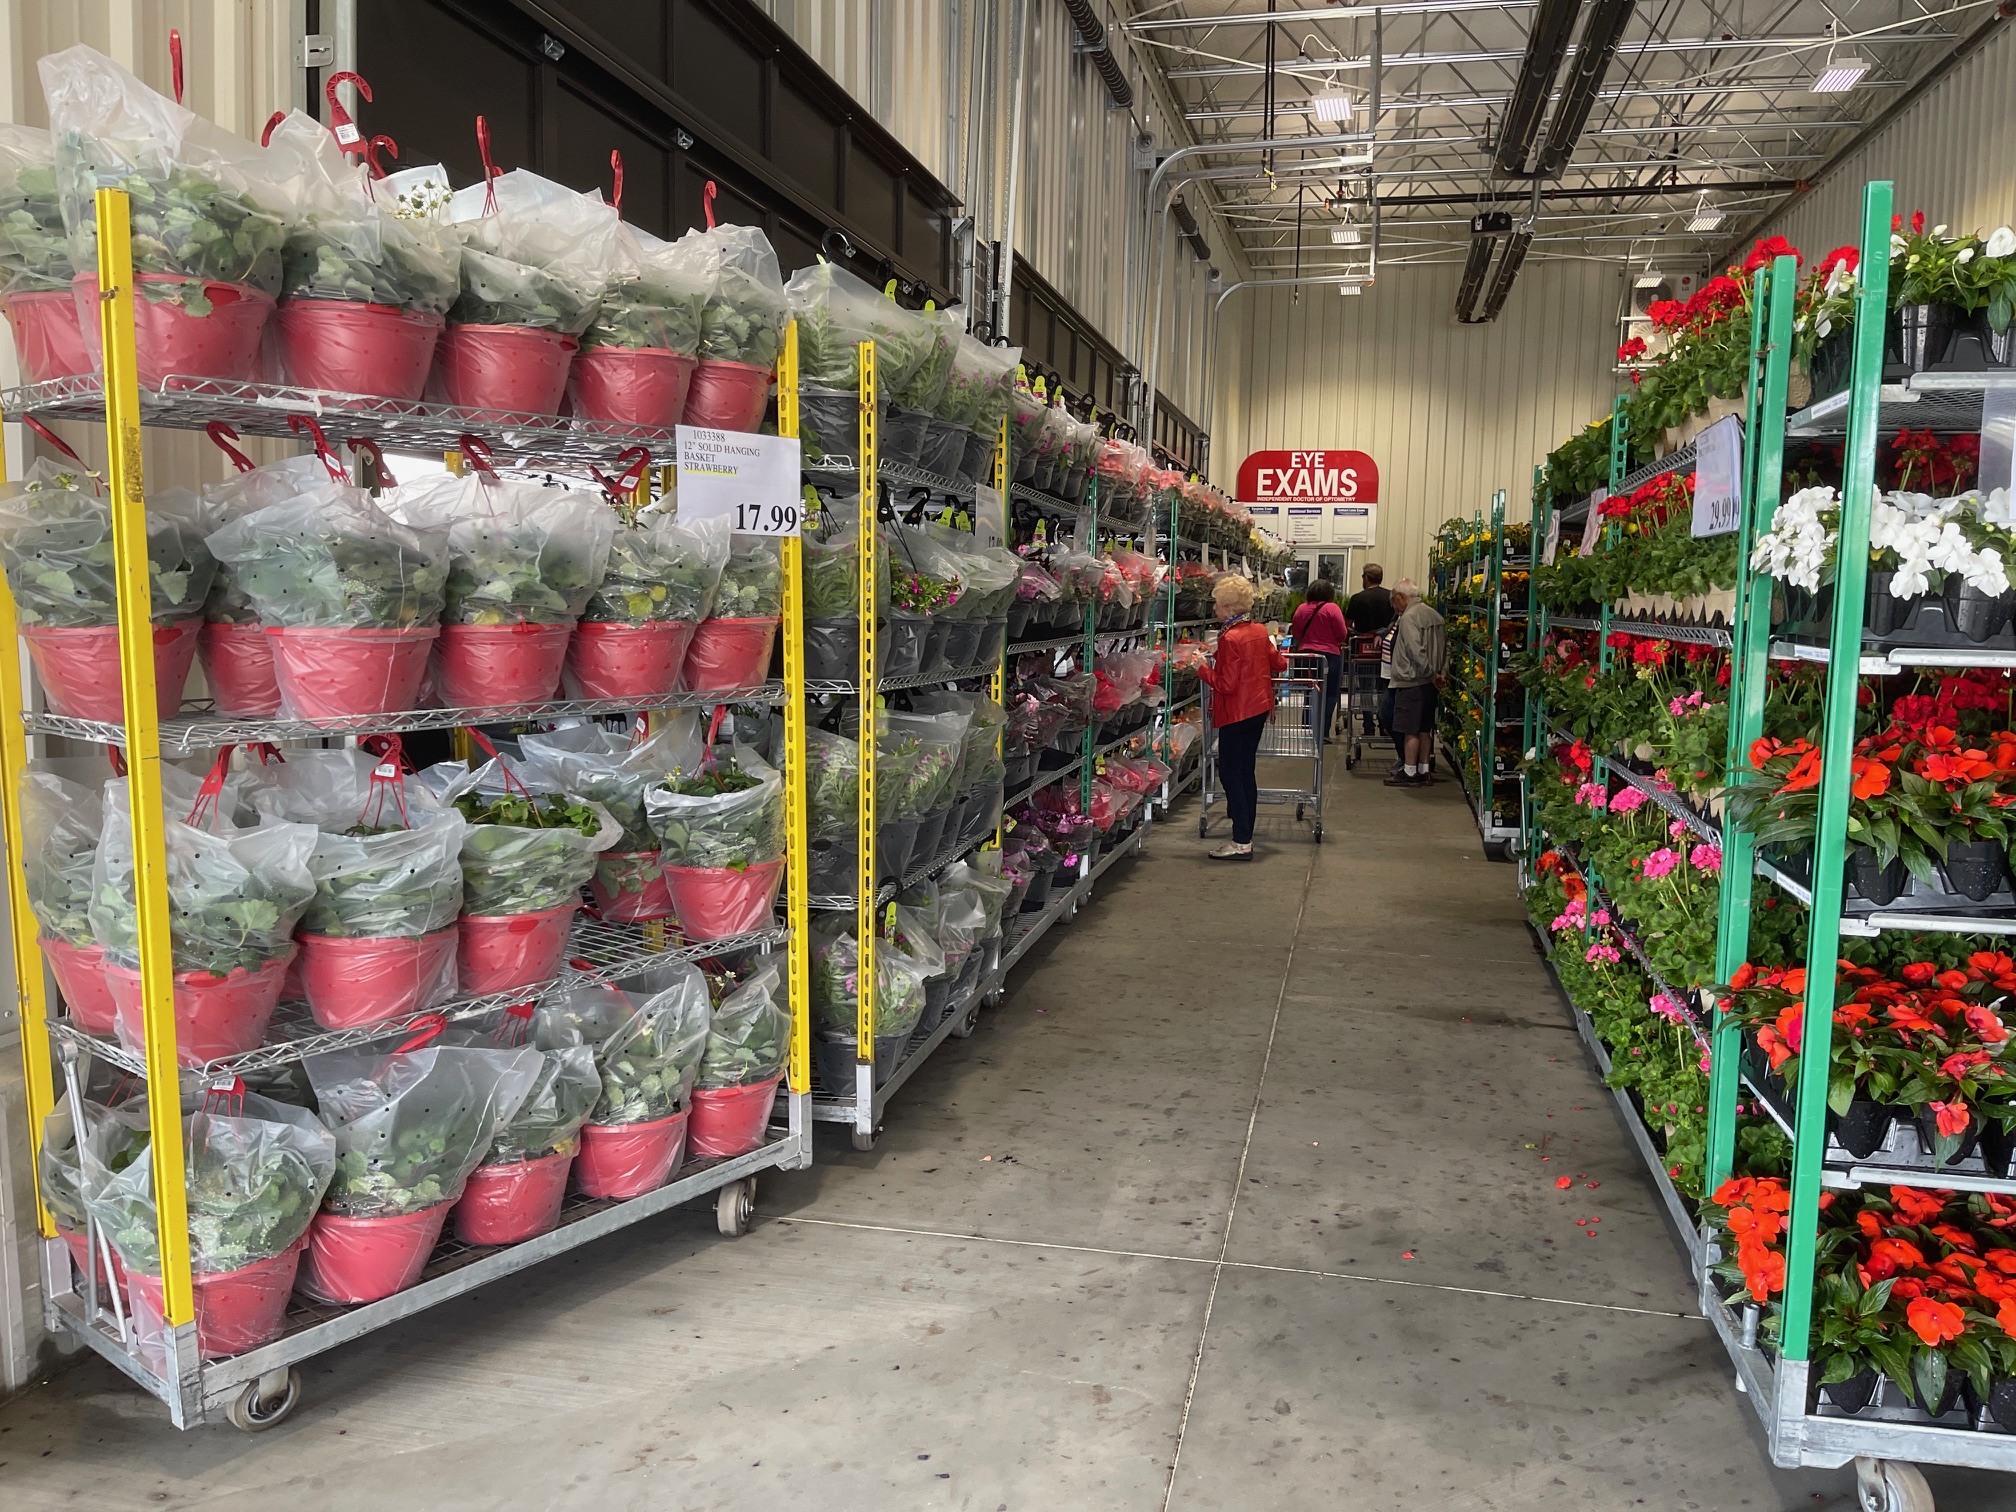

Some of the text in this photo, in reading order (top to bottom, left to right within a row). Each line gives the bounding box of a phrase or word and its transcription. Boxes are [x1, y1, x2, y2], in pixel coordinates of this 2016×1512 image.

[693, 430, 726, 442] 1033388
[684, 441, 760, 457] 12" SOLID HANGING
[684, 452, 716, 463] BASKET
[1291, 452, 1325, 468] EYE
[684, 462, 739, 474] STRAWBERRY
[1257, 468, 1358, 497] EXAMS
[736, 503, 797, 532] 17.99
